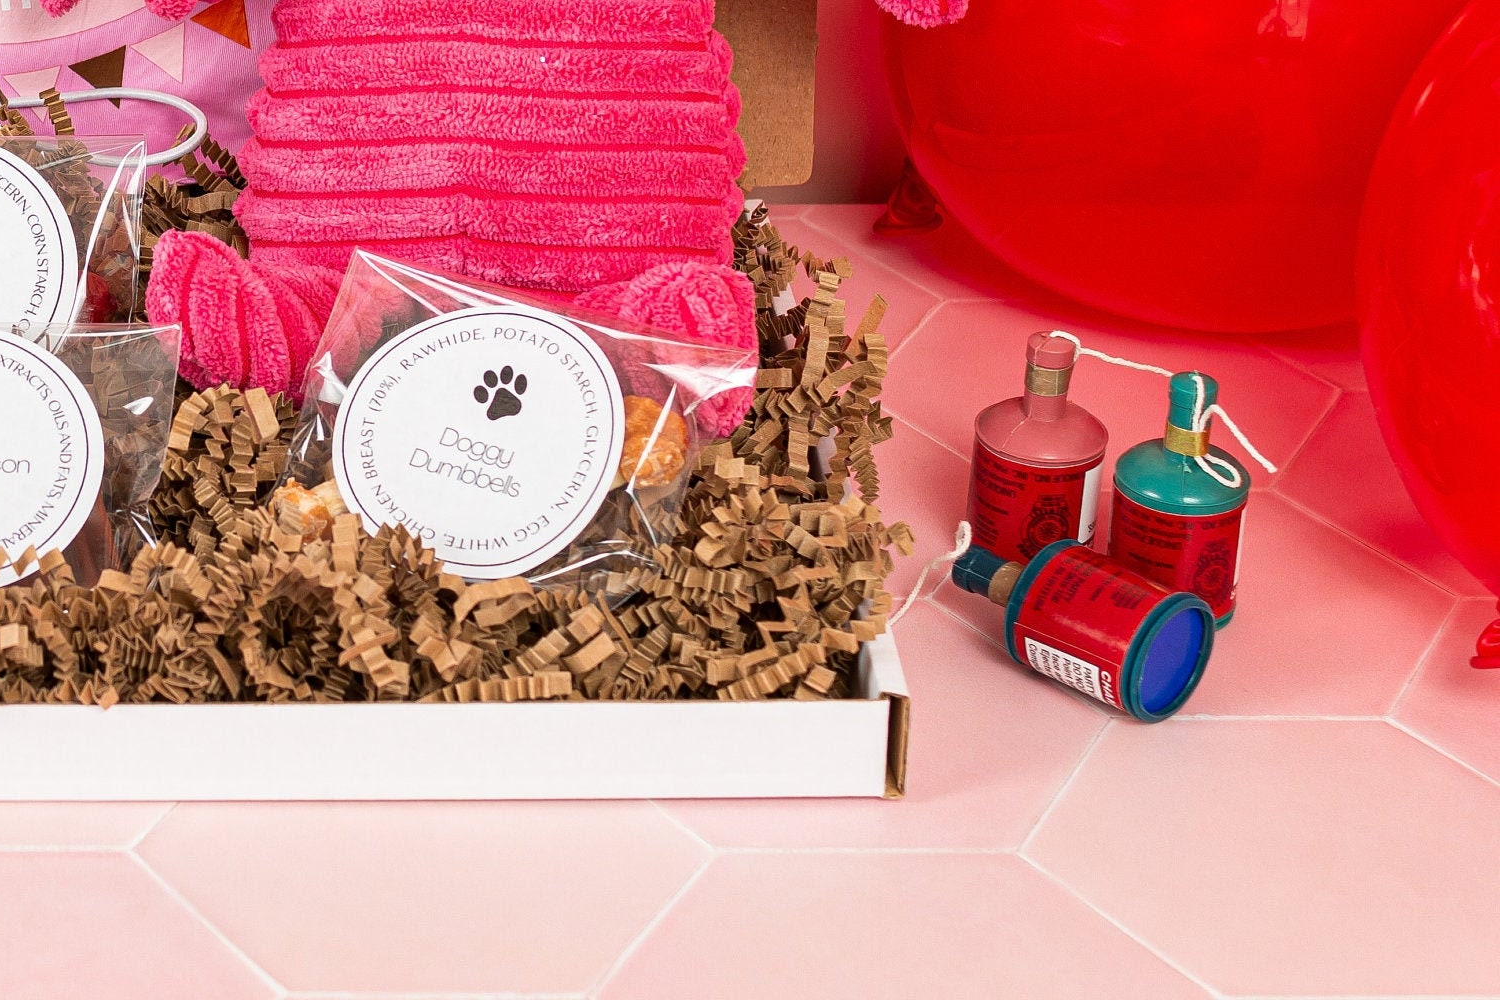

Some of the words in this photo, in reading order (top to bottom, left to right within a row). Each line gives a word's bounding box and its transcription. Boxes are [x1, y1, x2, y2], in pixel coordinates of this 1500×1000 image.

[26, 213, 48, 256] CORN
[493, 326, 560, 356] POTATO
[47, 399, 70, 431] OILS
[59, 433, 73, 464] AND
[359, 416, 379, 480] BREAST
[438, 426, 516, 469] Doggy
[408, 447, 522, 499] Dumbbells
[372, 484, 436, 541] CHICKEN
[513, 514, 551, 543] EGG
